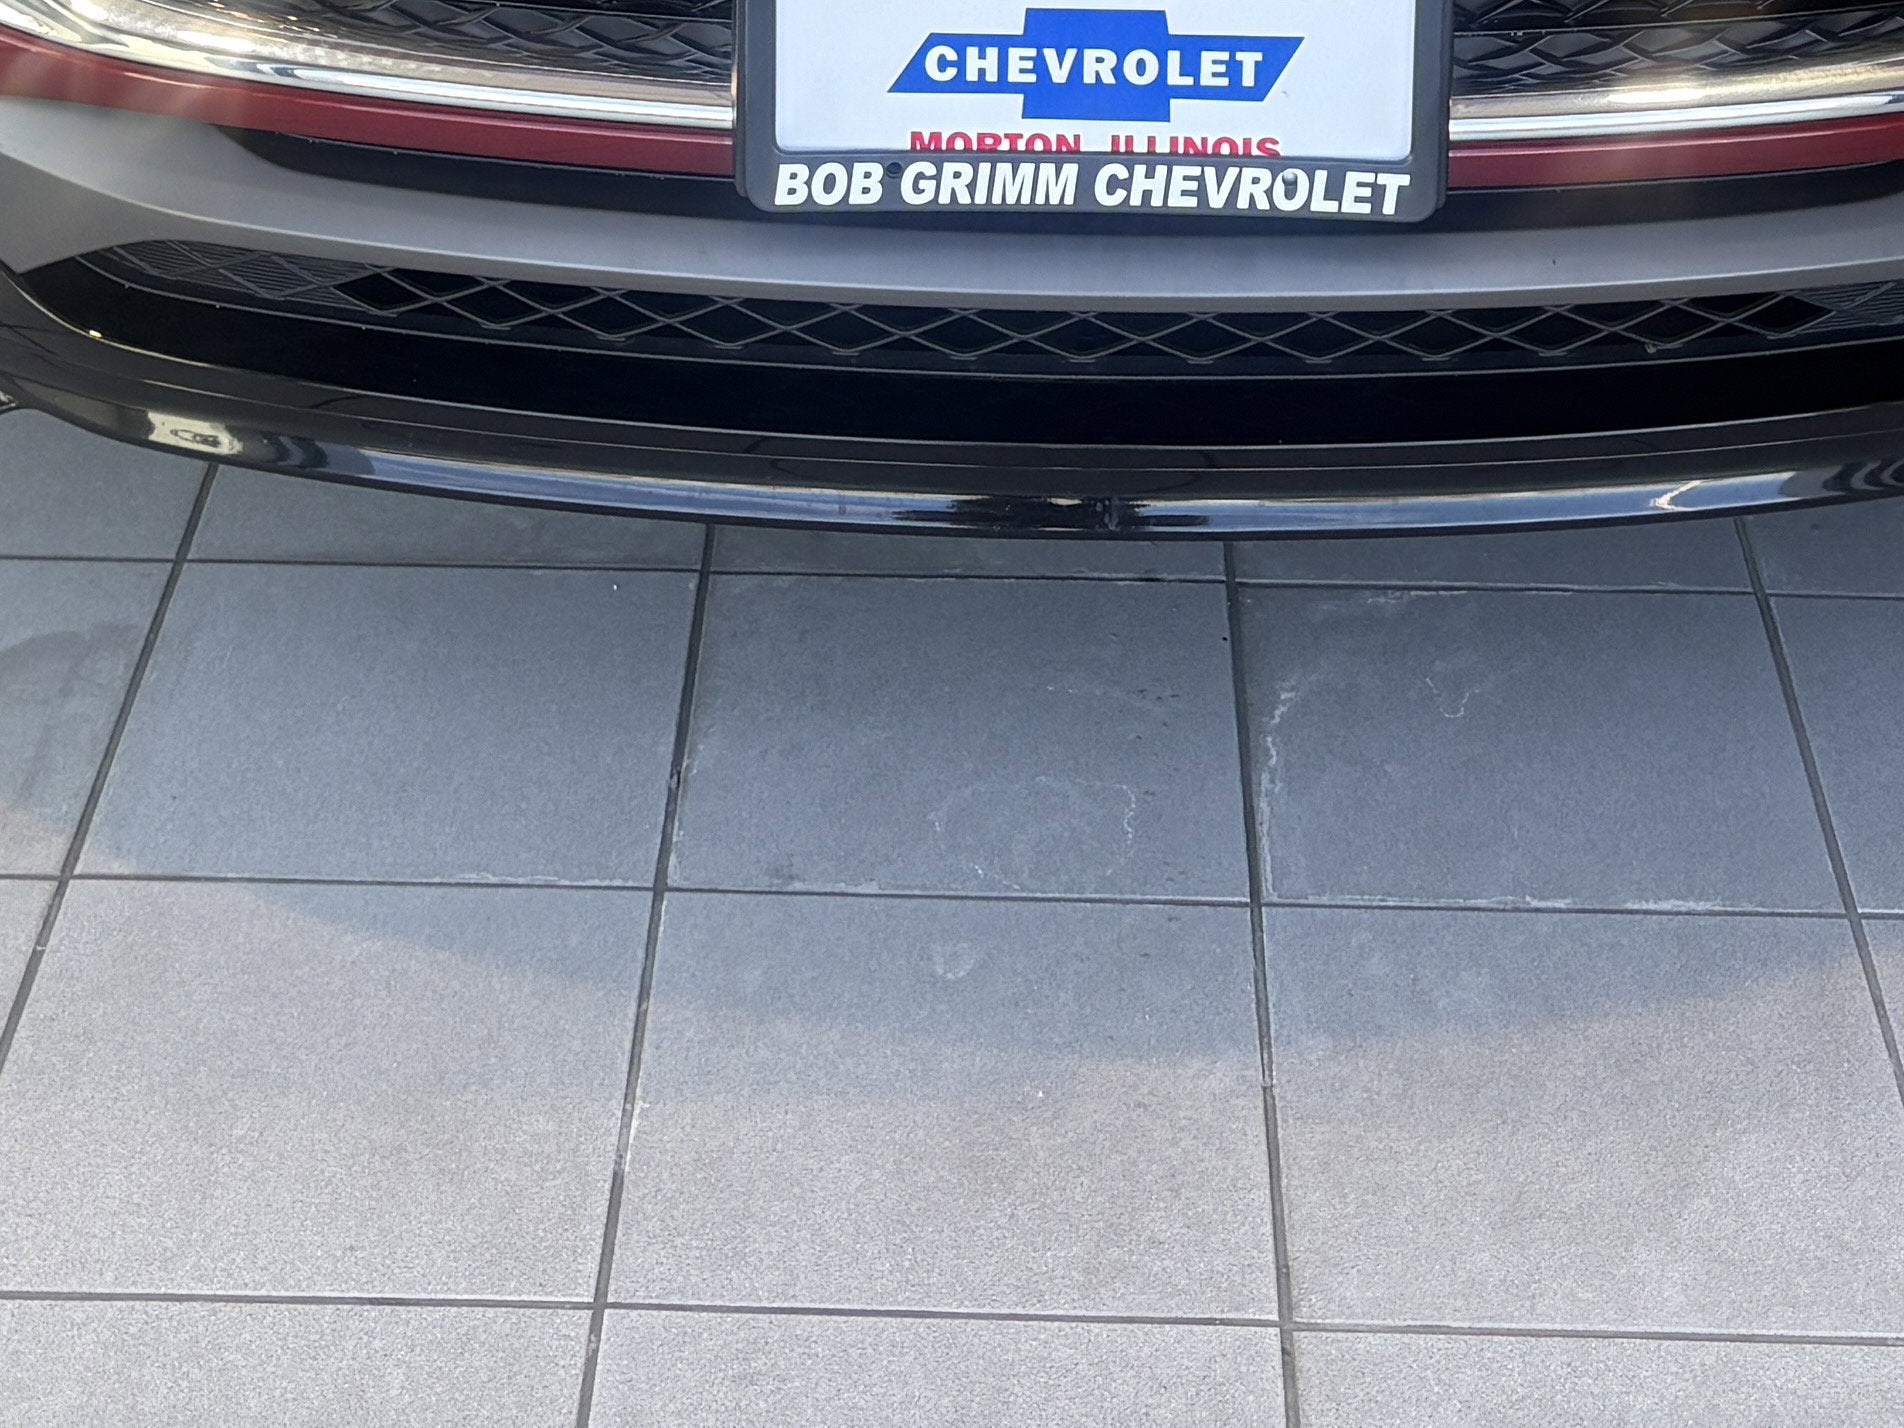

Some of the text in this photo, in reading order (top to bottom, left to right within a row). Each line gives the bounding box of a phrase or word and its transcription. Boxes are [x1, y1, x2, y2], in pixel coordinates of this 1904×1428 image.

[924, 44, 1264, 88] CHEVROLET
[773, 161, 1411, 215] BOB GRIMM CHEVROLET
